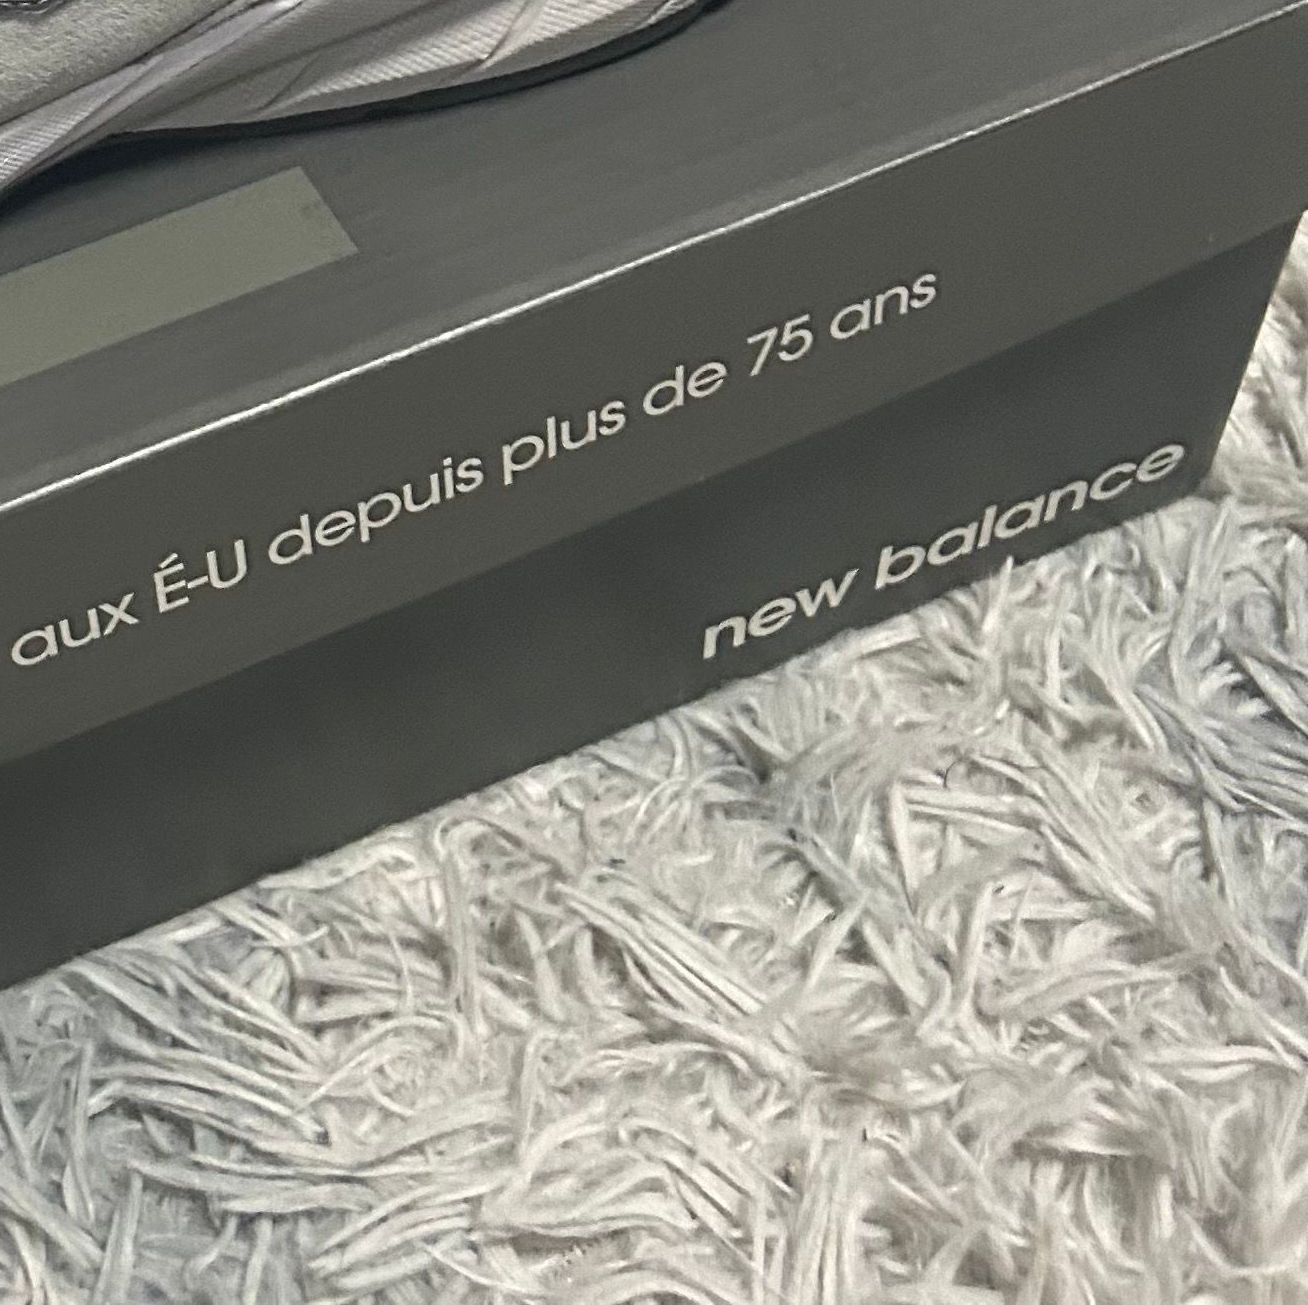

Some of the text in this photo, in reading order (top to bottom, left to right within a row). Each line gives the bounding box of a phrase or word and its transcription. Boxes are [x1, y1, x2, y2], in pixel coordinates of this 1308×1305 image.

[9, 591, 141, 667] aux
[152, 551, 248, 615] É-U
[266, 455, 485, 566] depuis
[500, 399, 627, 487] plus
[641, 360, 728, 417] de
[745, 312, 815, 378] 75
[828, 272, 938, 341] ans
[702, 443, 1186, 660] new balance
